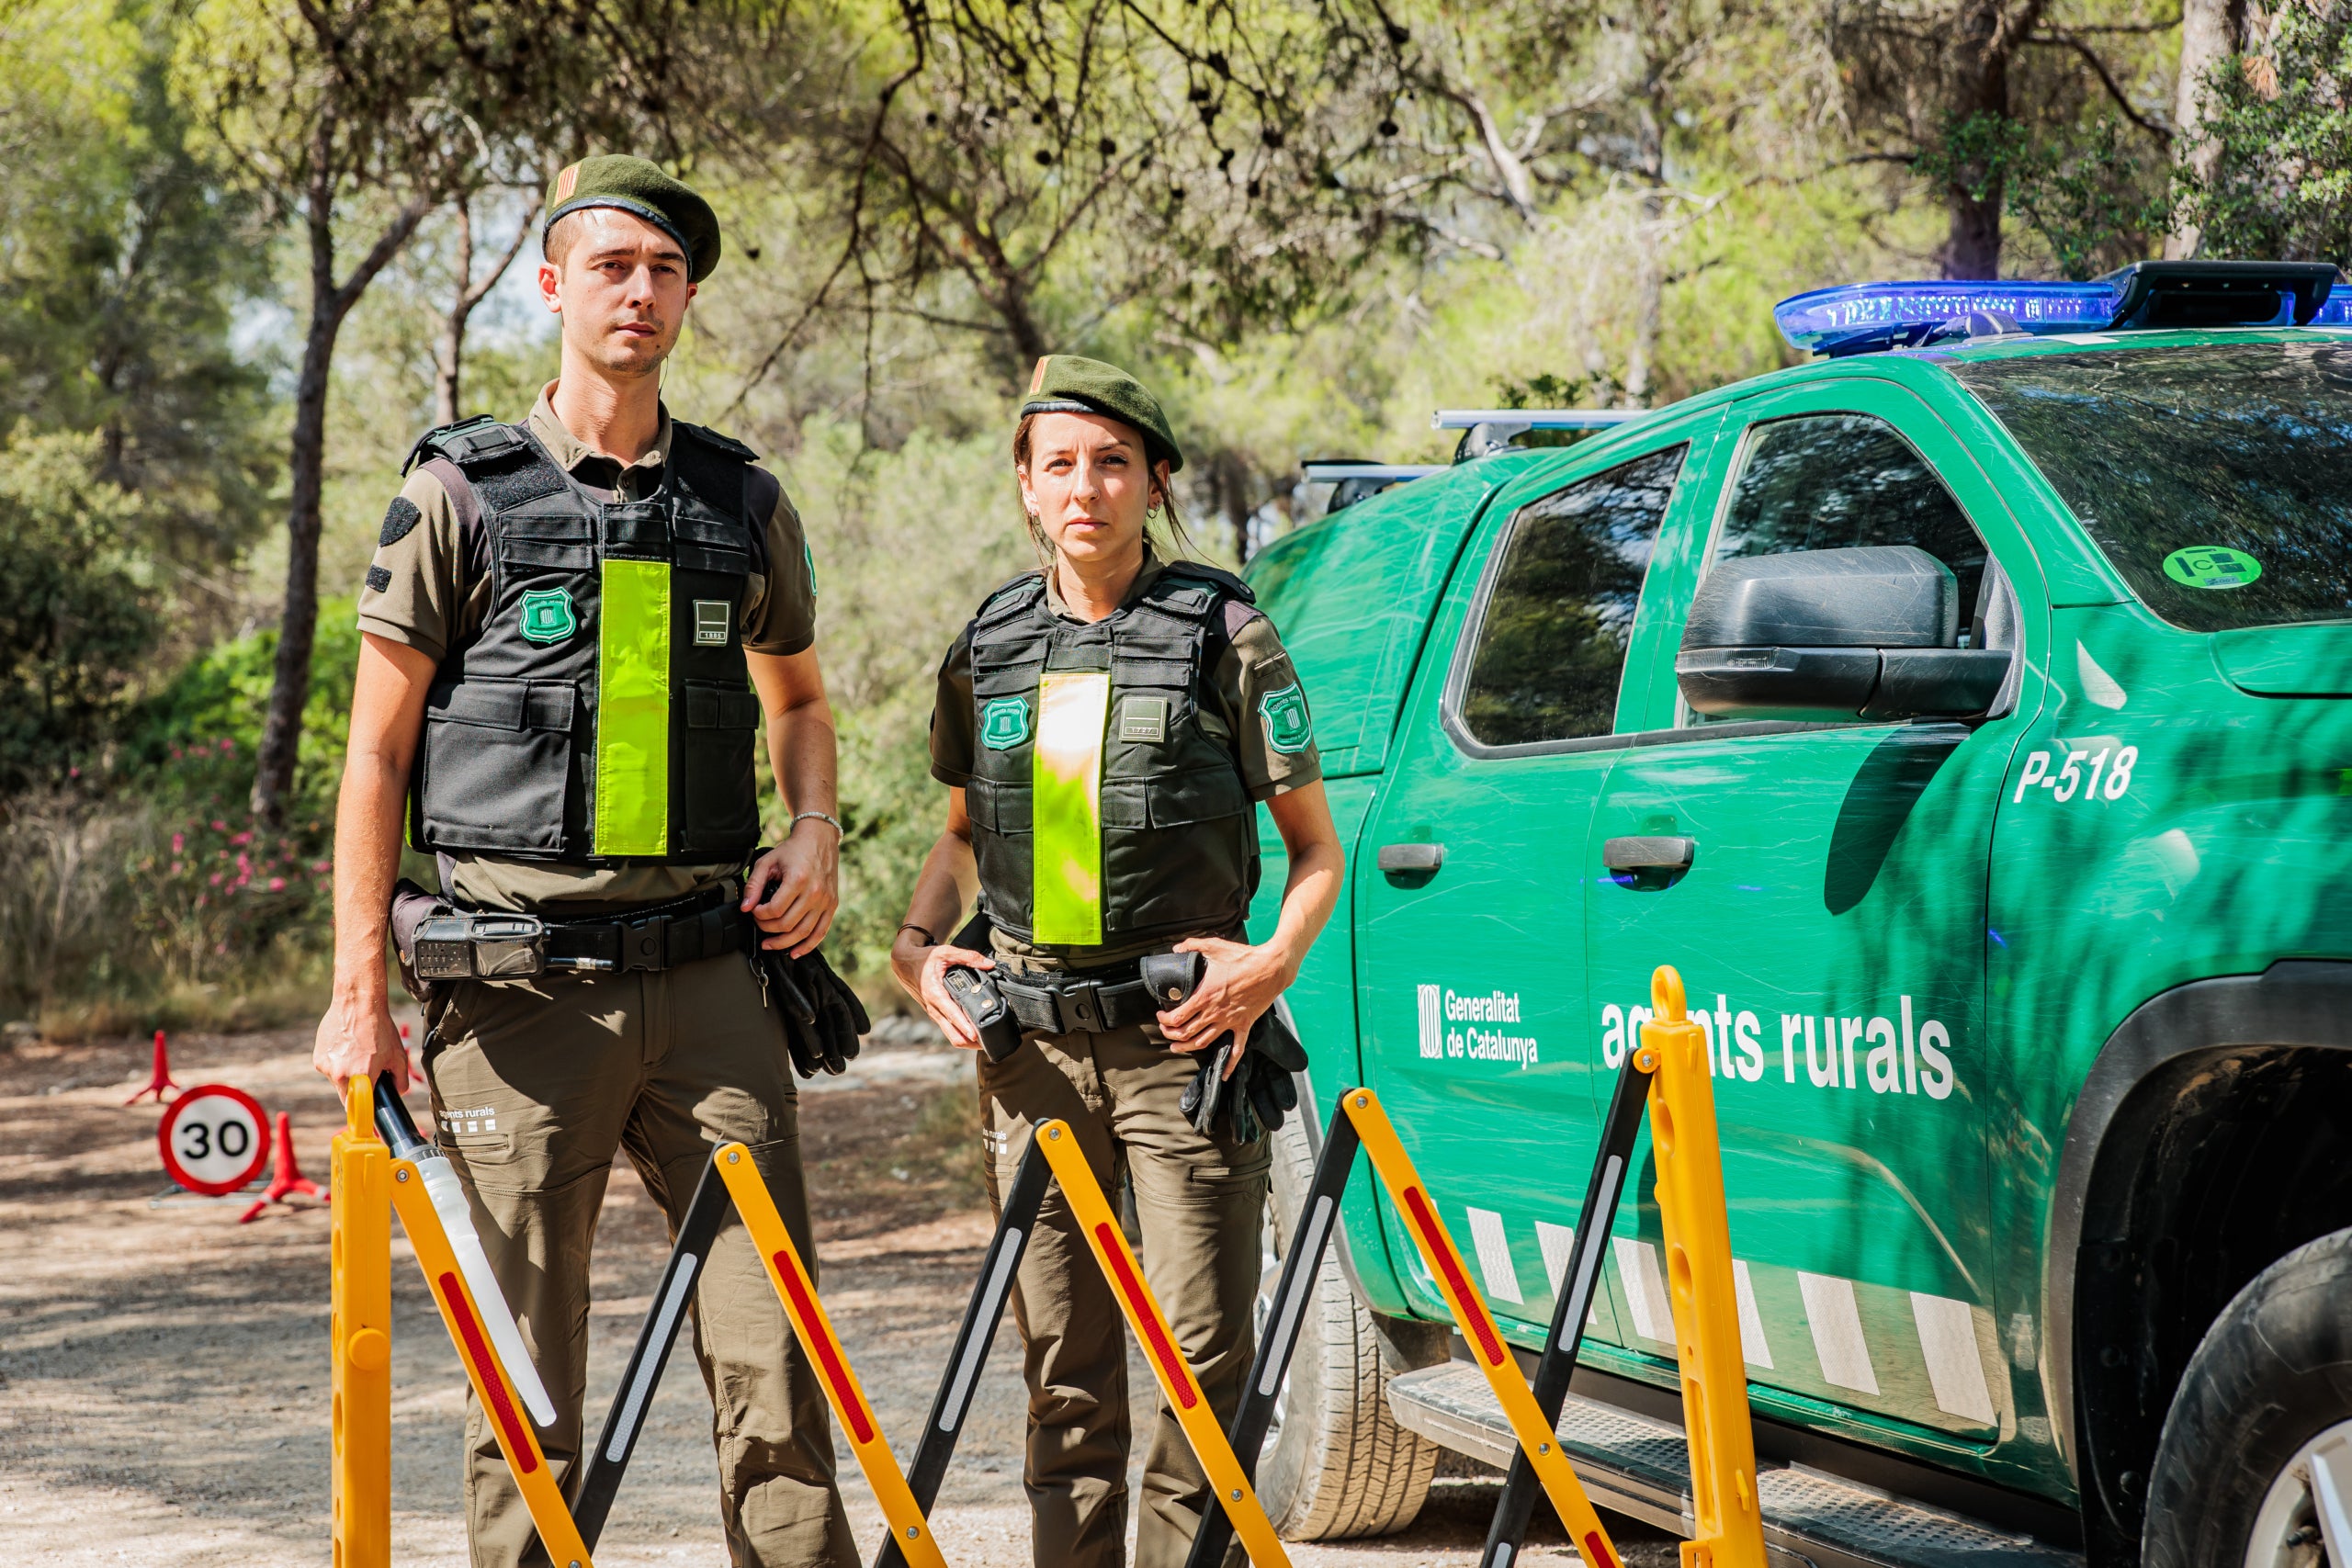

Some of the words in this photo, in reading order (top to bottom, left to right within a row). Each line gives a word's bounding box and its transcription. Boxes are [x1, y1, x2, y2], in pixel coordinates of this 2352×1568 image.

[2013, 745, 2139, 804] P-518
[1444, 988, 1521, 1023] Generalitat
[1446, 1026, 1464, 1059] de
[1466, 1026, 1539, 1071] Catalunya
[1601, 994, 1764, 1082] ants
[1781, 995, 1954, 1100] rurals
[465, 1106, 495, 1118] rurals
[183, 1120, 249, 1160] 30
